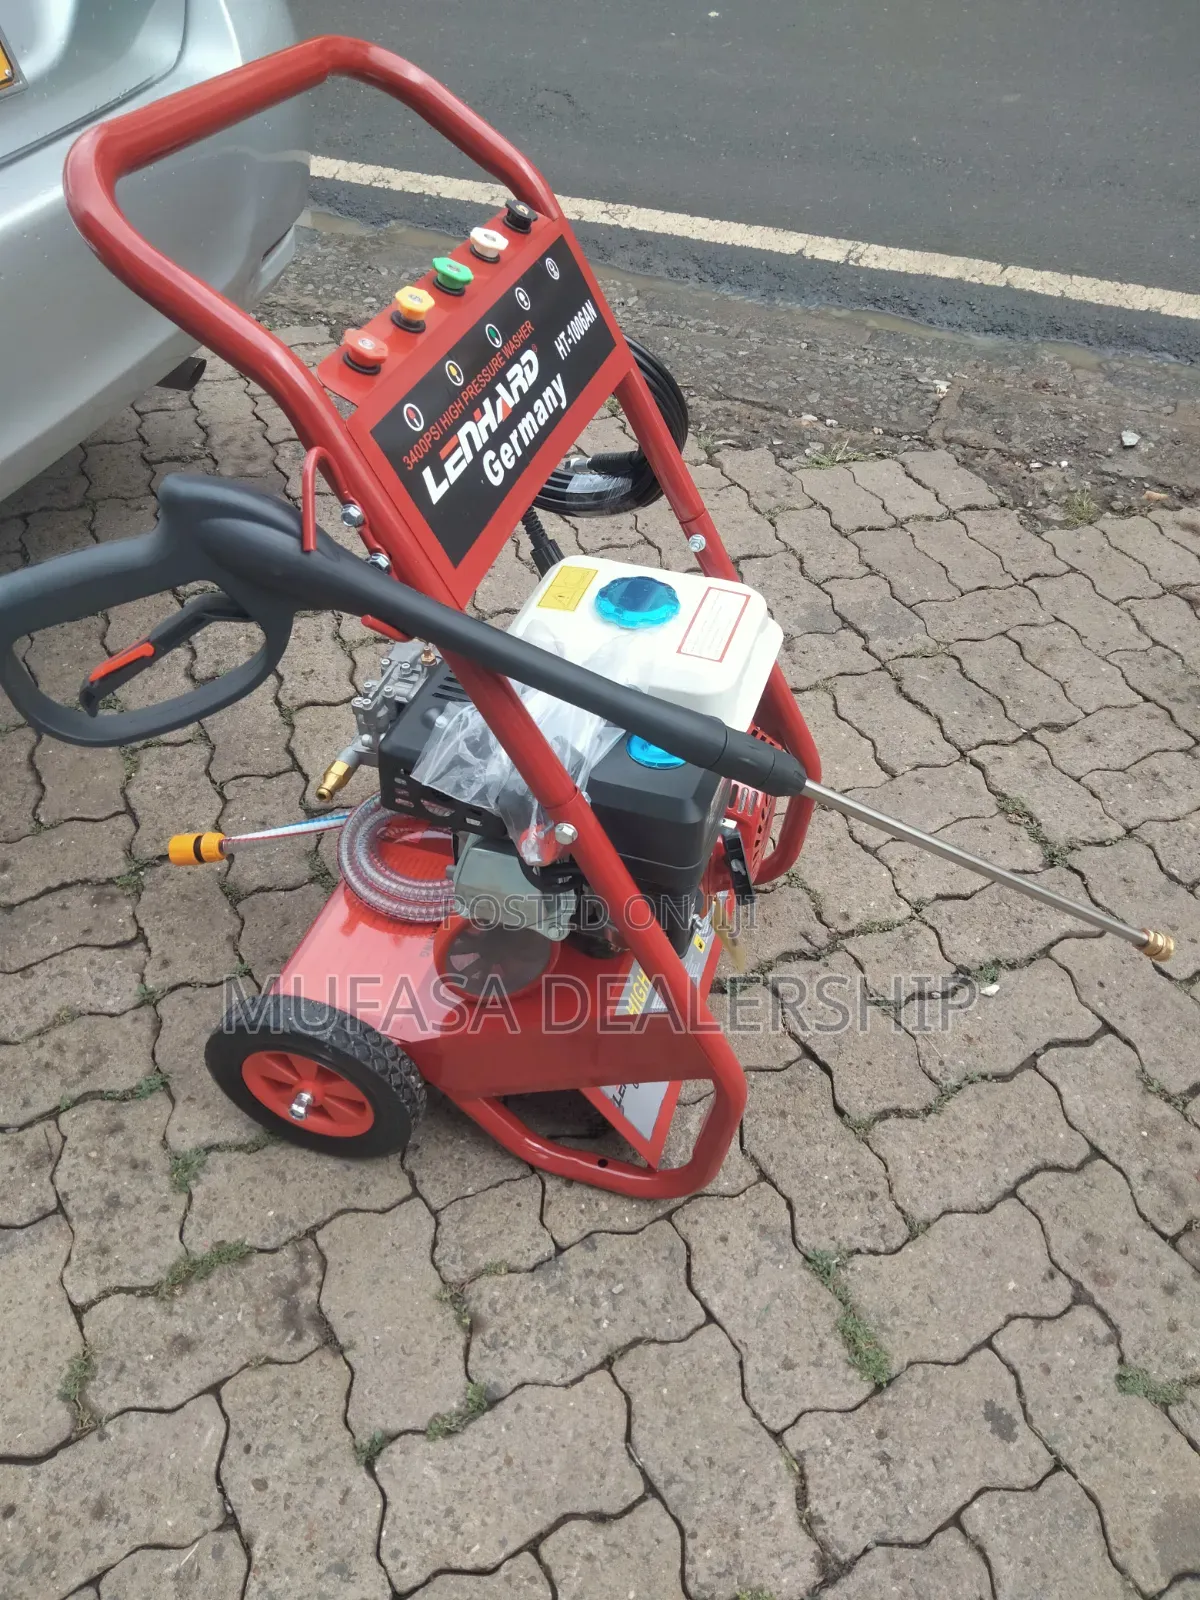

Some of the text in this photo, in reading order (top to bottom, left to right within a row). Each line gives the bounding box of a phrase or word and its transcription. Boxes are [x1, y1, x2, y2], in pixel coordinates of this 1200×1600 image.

[554, 300, 597, 360] HT-1006AN
[402, 320, 535, 471] 3400PSI HIGH PRESSURE WASHER
[421, 349, 539, 505] LENHARD
[482, 372, 567, 487] Germany
[625, 968, 652, 1015] HIGH
